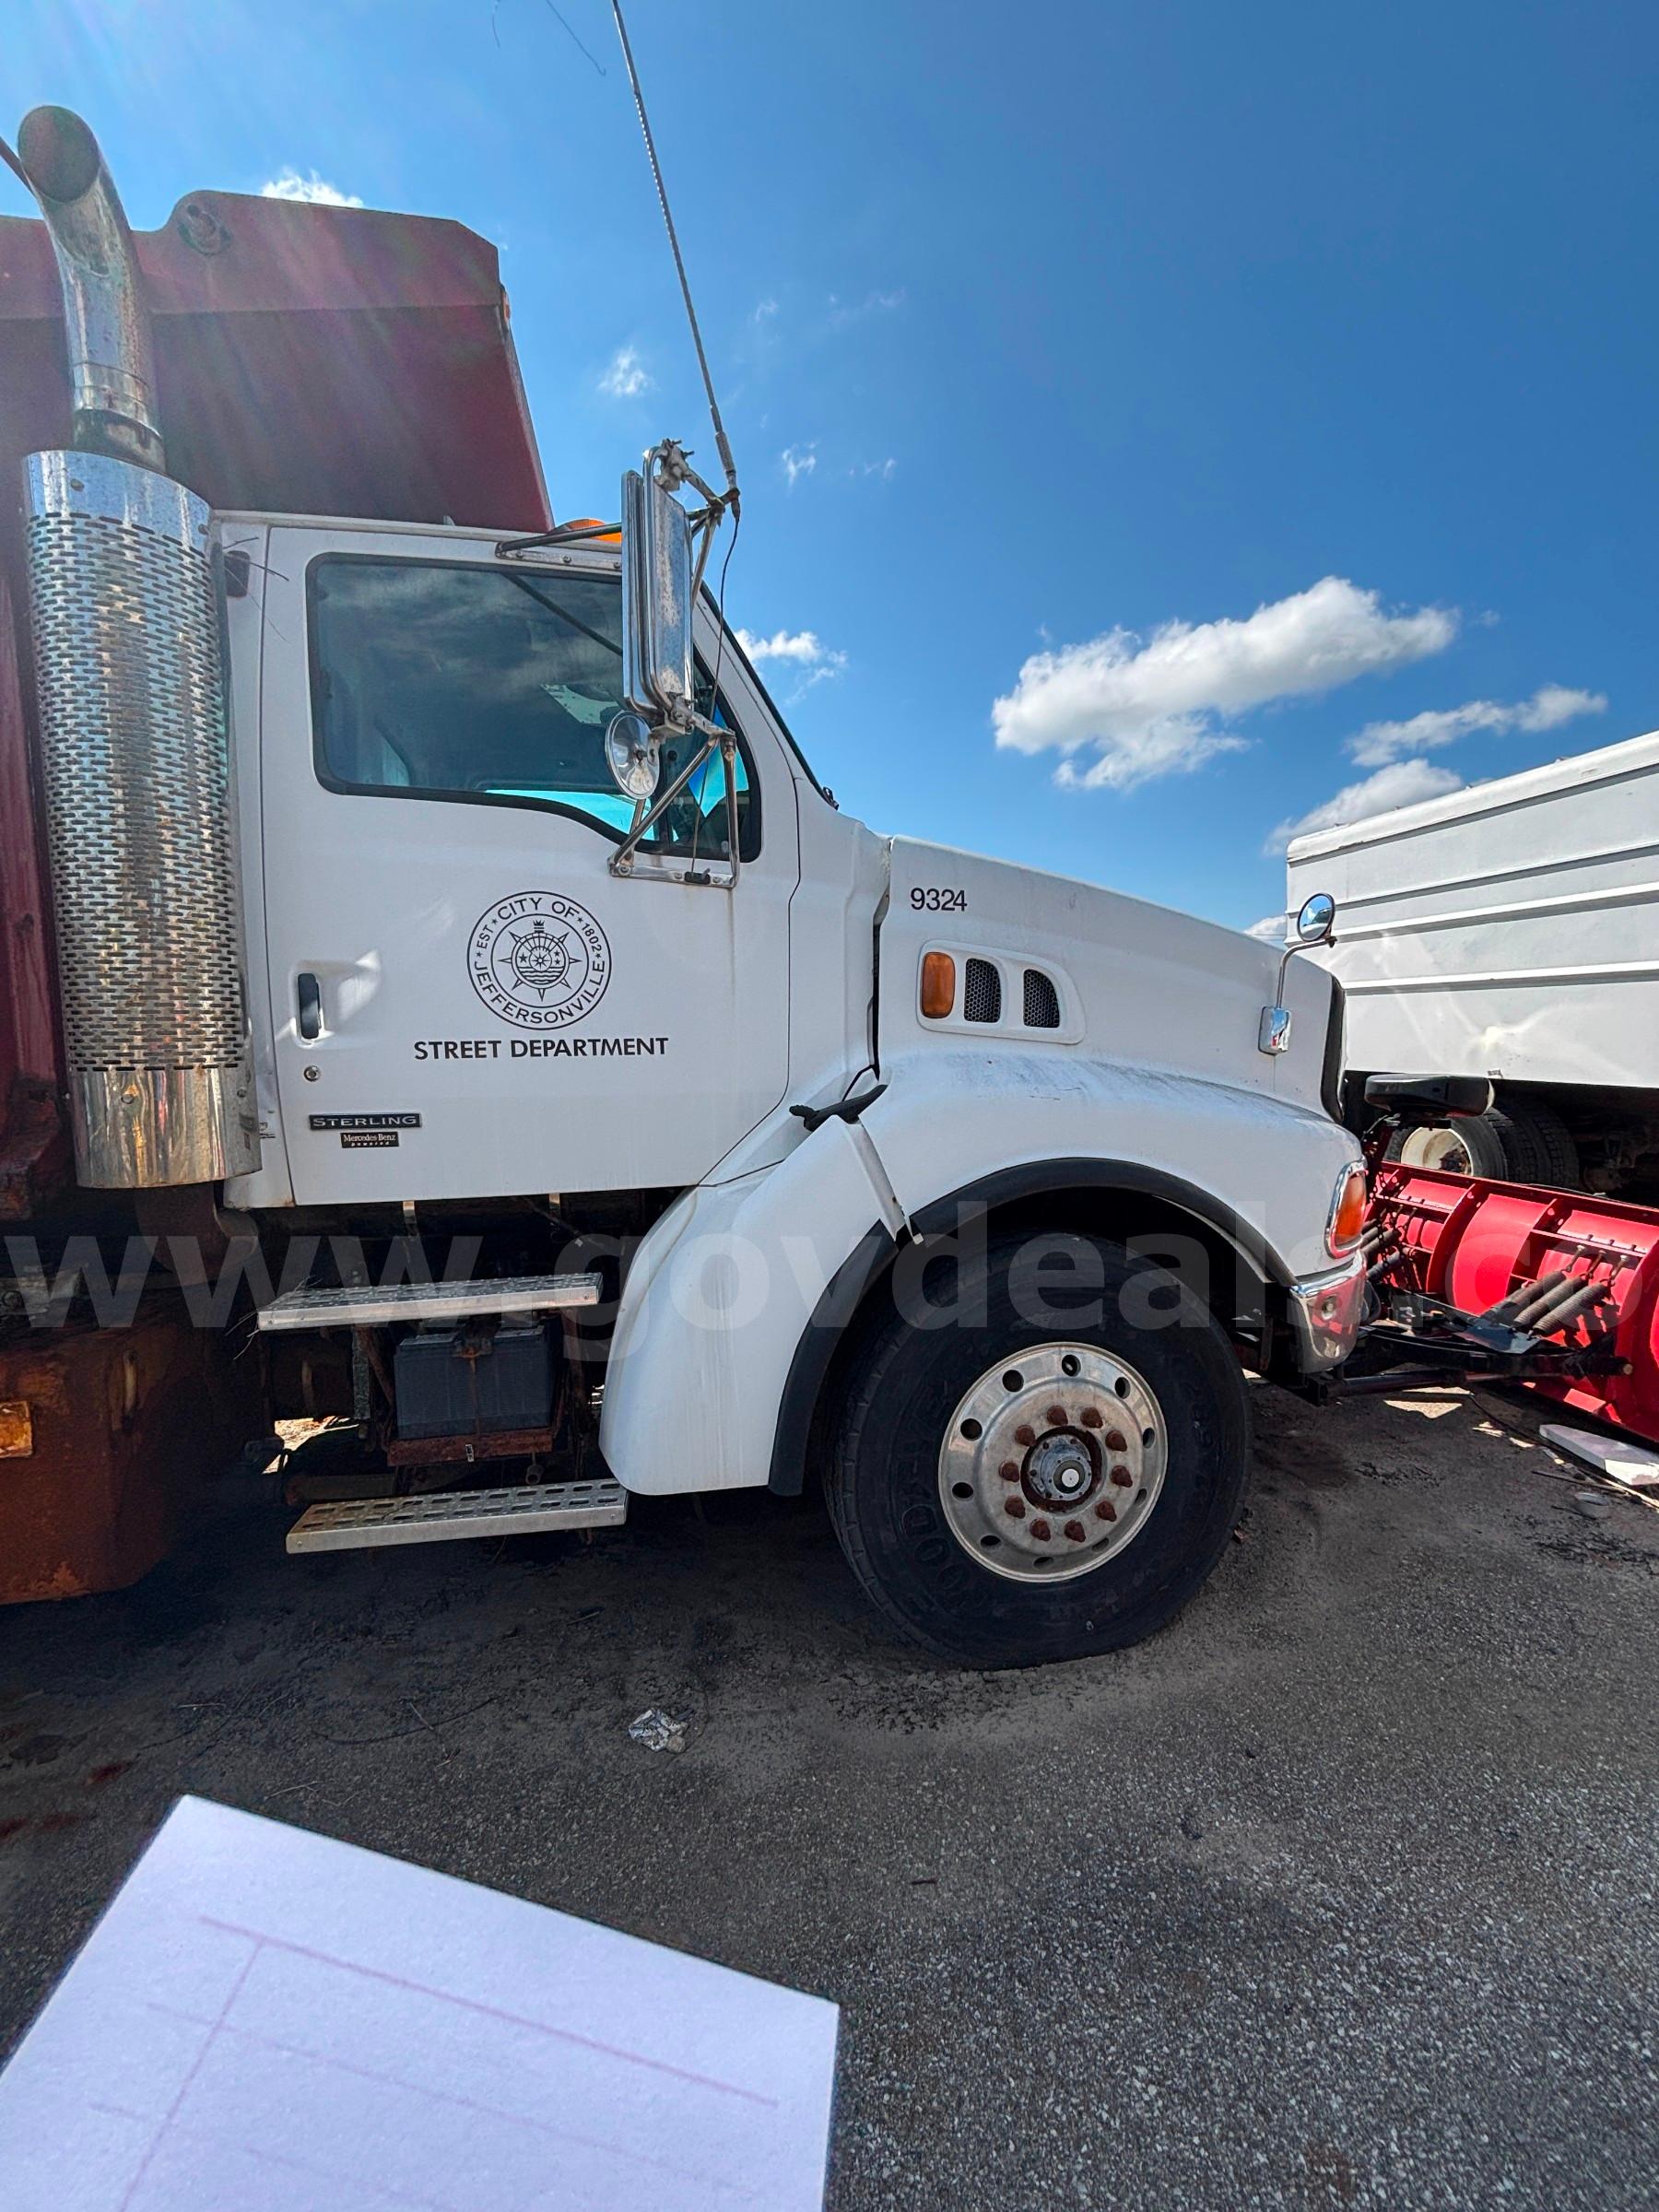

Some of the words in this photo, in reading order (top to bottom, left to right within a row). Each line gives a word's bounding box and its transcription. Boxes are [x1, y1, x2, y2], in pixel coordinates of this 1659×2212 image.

[497, 897, 543, 921] CITY
[551, 900, 580, 918] OF
[911, 888, 968, 912] 9324
[477, 924, 495, 949] EST
[582, 923, 603, 953] 1802
[475, 959, 606, 1024] JEFFERSONVILLE
[415, 1041, 502, 1060] STREET
[511, 1038, 669, 1058] DEPARTMENT
[313, 1115, 416, 1126] STERLING
